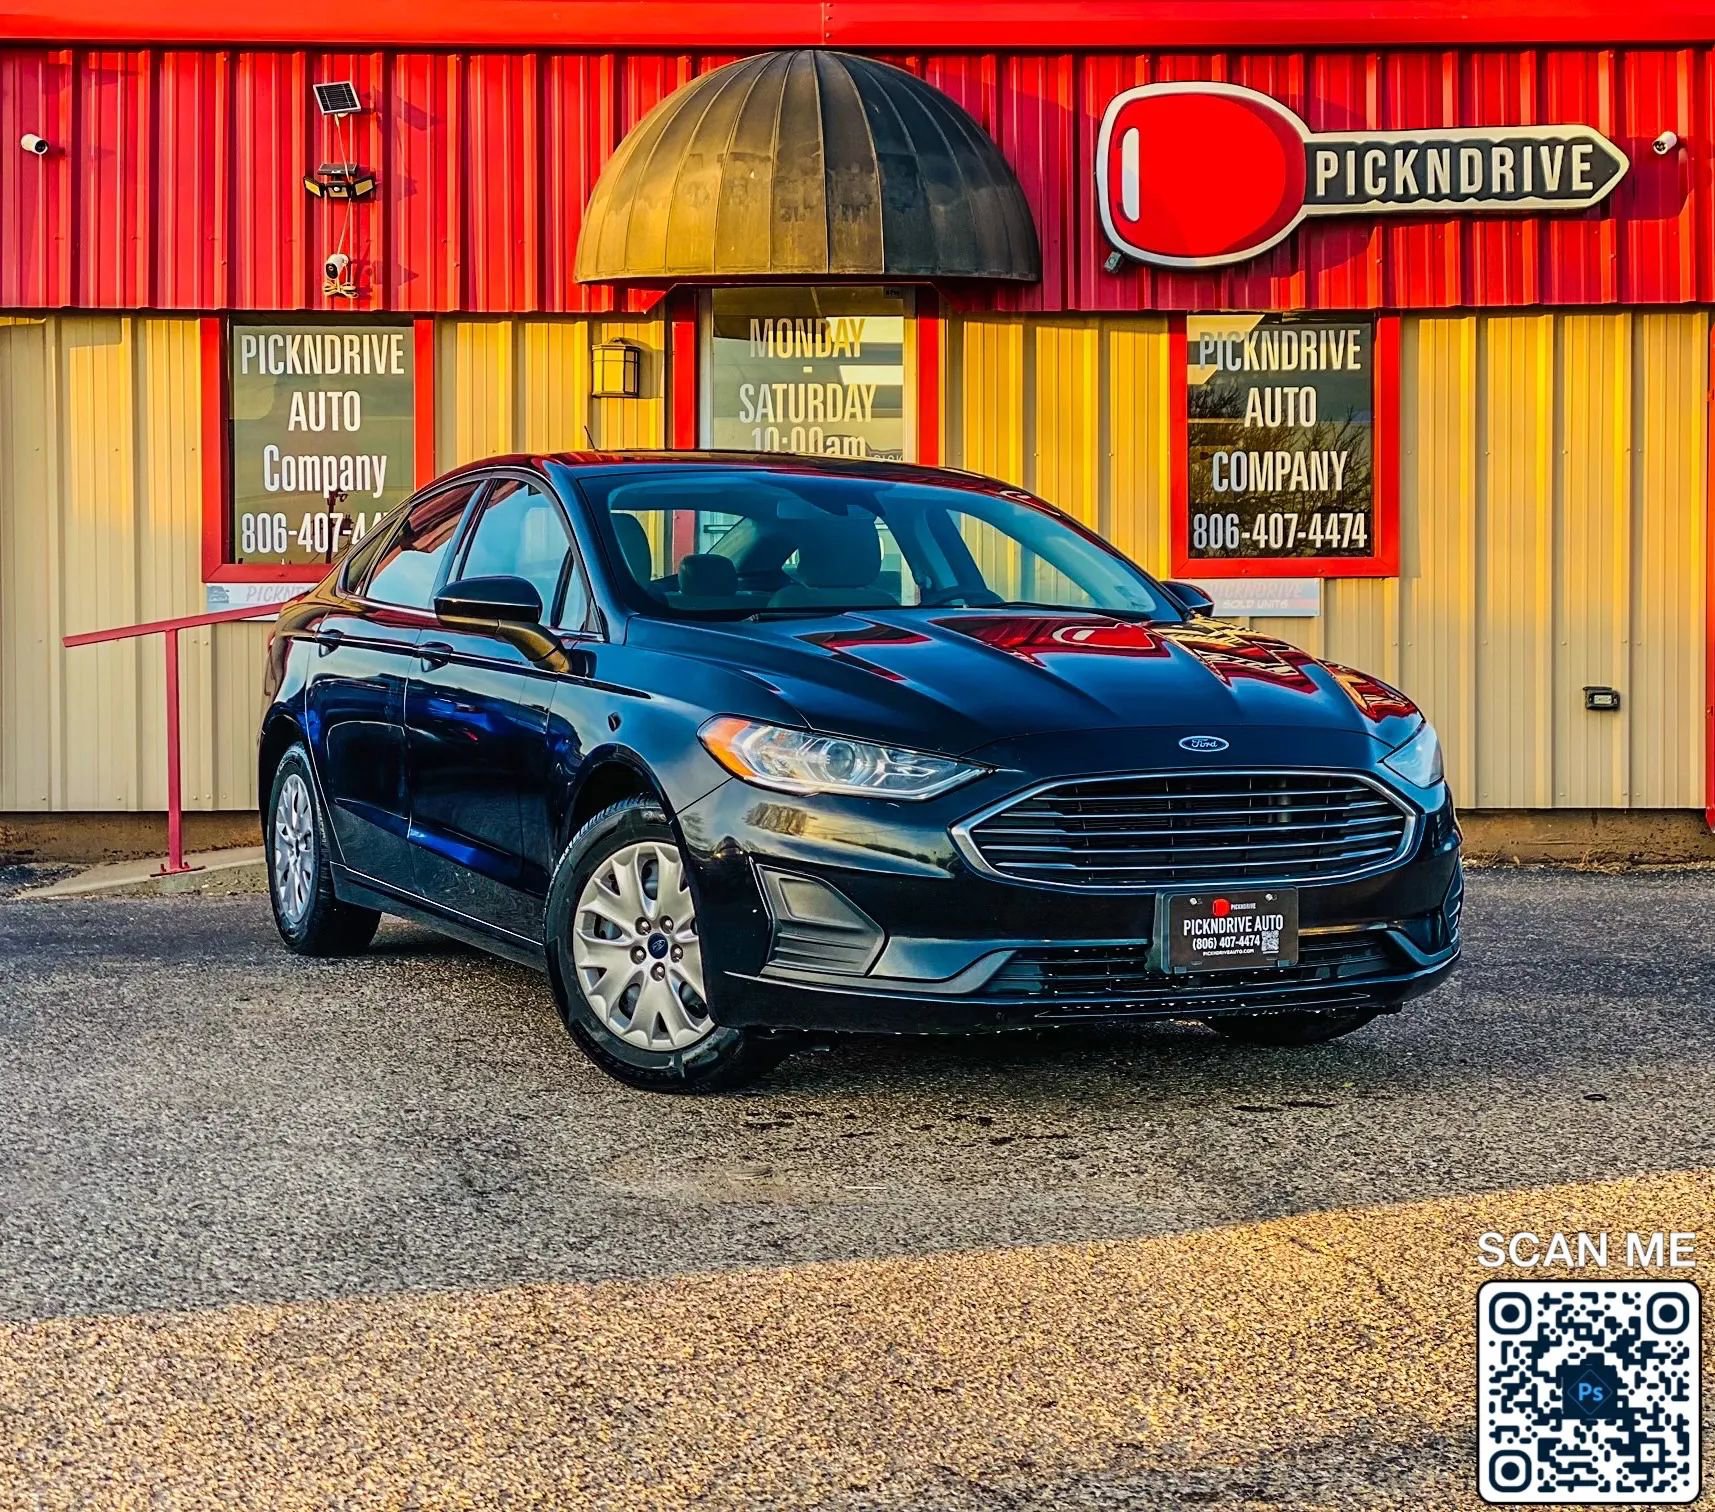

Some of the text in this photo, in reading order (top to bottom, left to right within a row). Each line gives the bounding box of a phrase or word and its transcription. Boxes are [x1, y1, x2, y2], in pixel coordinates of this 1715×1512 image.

[1316, 144, 1593, 196] PICKNDRIVE
[241, 334, 404, 375] PICKNDRIVE
[751, 318, 865, 358] MONDAY
[1200, 329, 1361, 371] PICKNDRIVE
[288, 391, 361, 432] AUTO
[739, 383, 877, 423] SATURDAY
[1244, 387, 1317, 428] AUTO
[263, 444, 387, 499] Company
[1212, 451, 1348, 492] COMPANY
[241, 512, 389, 554] 806-407-4
[1193, 513, 1367, 550] 806-407-4474
[1191, 738, 1218, 748] Ford
[1183, 914, 1284, 936] PICKNDRIVE AUTO
[1192, 934, 1260, 951] (806) 407-4474
